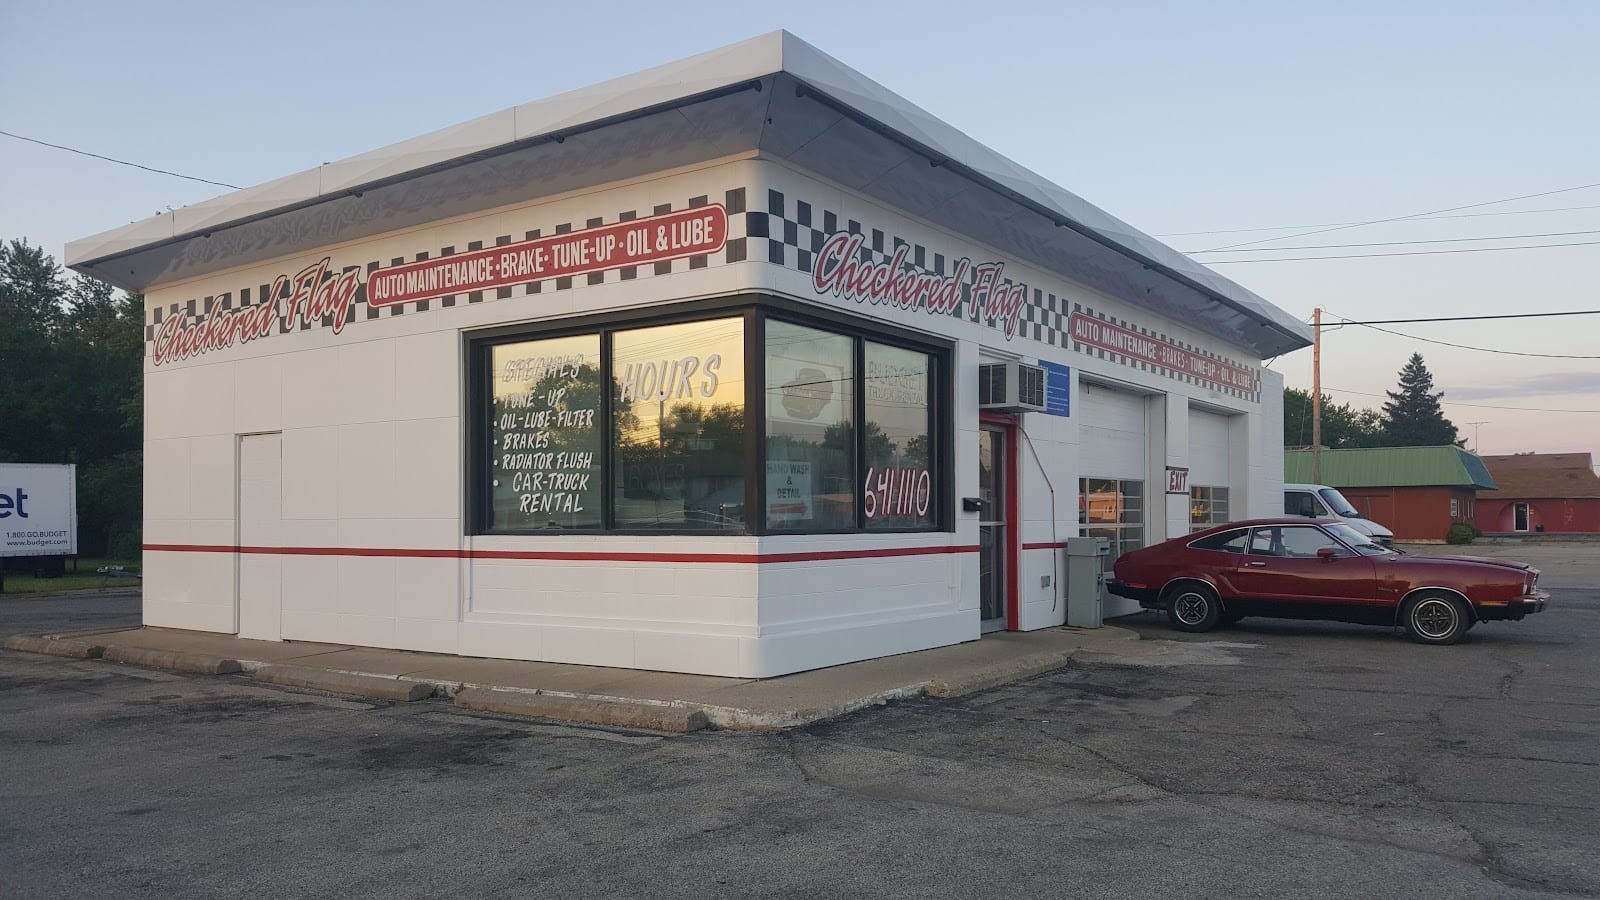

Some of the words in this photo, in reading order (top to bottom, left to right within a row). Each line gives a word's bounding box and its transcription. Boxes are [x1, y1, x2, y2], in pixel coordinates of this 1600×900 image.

[375, 274, 404, 299] AUTO
[407, 256, 494, 294] MAINTENANCE
[501, 246, 544, 277] BRAKE
[552, 234, 616, 269] TUNE-UP
[626, 229, 652, 257] OIL
[655, 224, 669, 252] &
[672, 215, 714, 249] LUBE
[812, 230, 970, 315] Checkered
[968, 262, 1026, 341] Flag
[153, 275, 287, 365] Checkered
[286, 257, 361, 335] Flag
[1075, 318, 1099, 341] AUTO
[1102, 326, 1157, 360] MAINTENANCE
[1162, 346, 1185, 369] BRAKES
[1190, 356, 1216, 378] TUNE-UP
[1221, 367, 1231, 383] OIL
[620, 354, 722, 402] HOURS
[501, 409, 594, 430] OIL-LUBE-FILTER
[503, 431, 550, 450] BRAKES
[502, 453, 553, 471] RADIATOR
[556, 452, 593, 470] FLUSH
[512, 471, 590, 492] CAR-TRUCK
[1169, 470, 1188, 491] EXIT
[519, 492, 584, 513] RENTAL
[6, 539, 68, 547] www.budget.com
